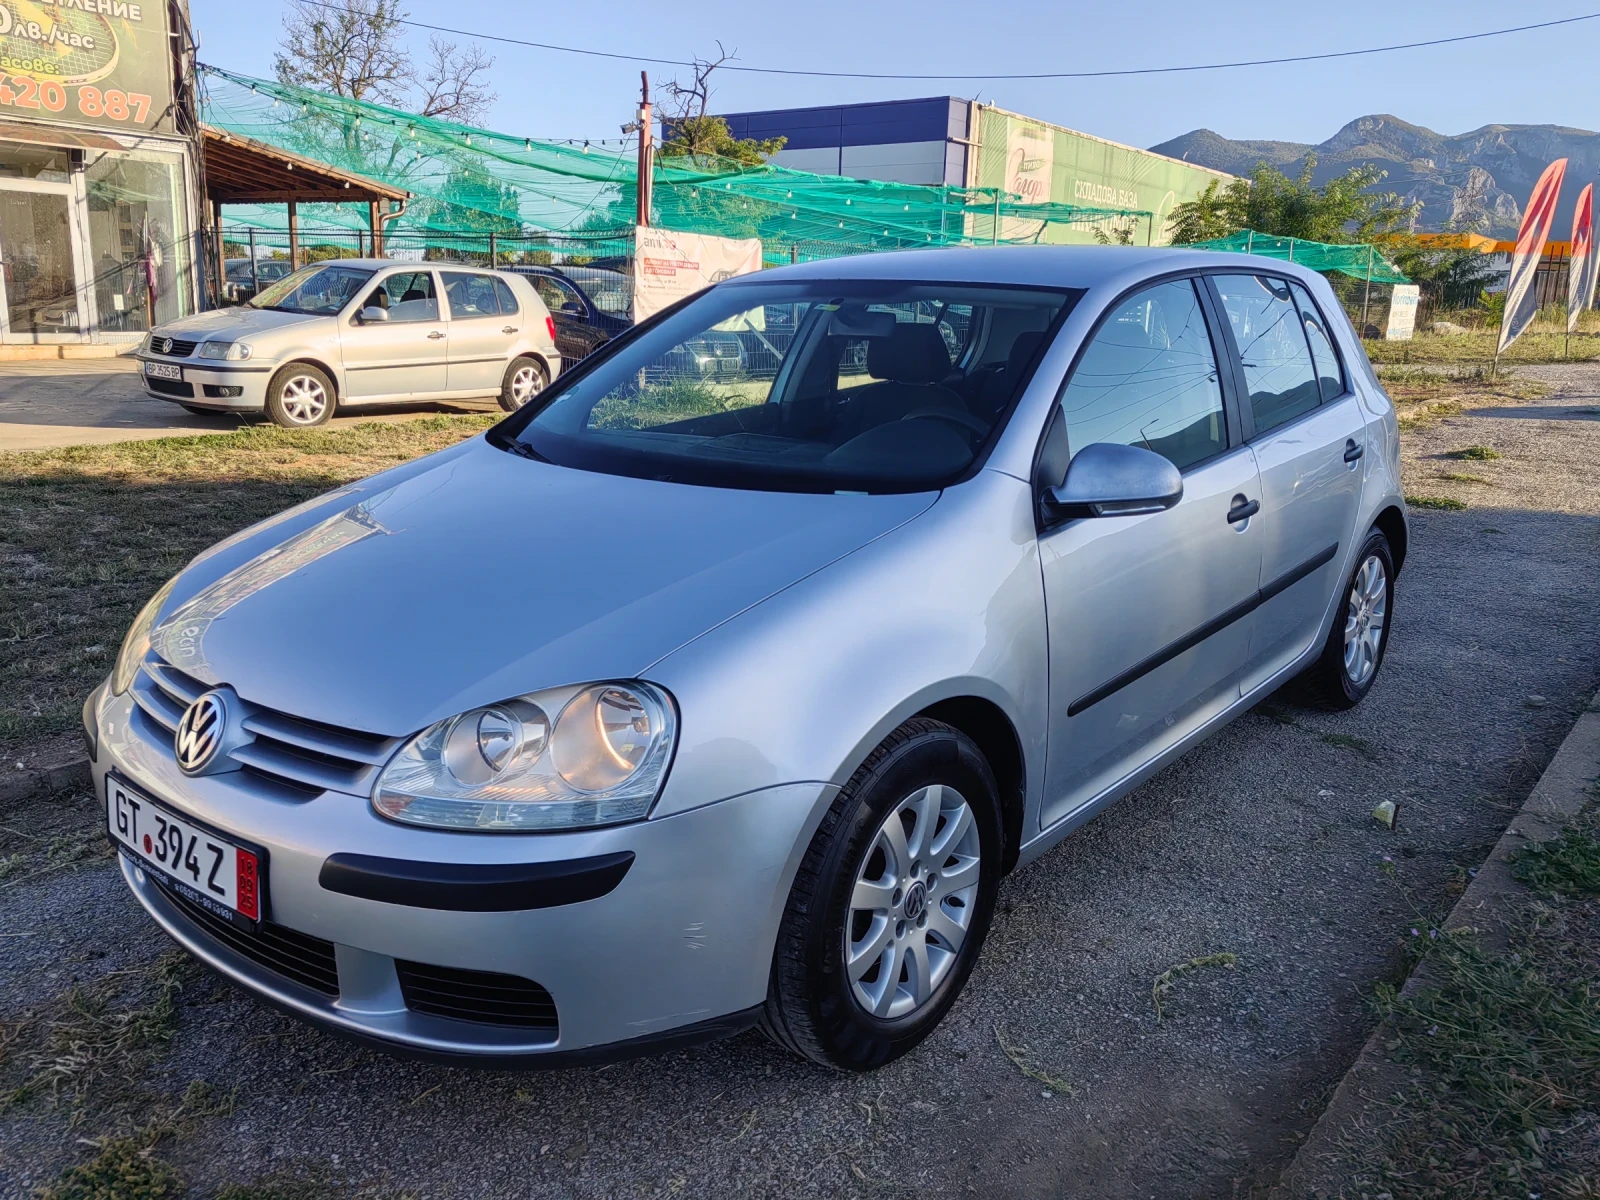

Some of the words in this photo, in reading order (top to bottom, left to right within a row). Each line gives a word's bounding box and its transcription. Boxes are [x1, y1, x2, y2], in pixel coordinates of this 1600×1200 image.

[41, 0, 142, 21] ЛЕНИЕ
[0, 75, 67, 113] 420
[78, 86, 152, 124] 887
[1074, 180, 1117, 206] СКЛАДОВА
[1118, 189, 1138, 209] БАЗА
[116, 788, 141, 844] GT
